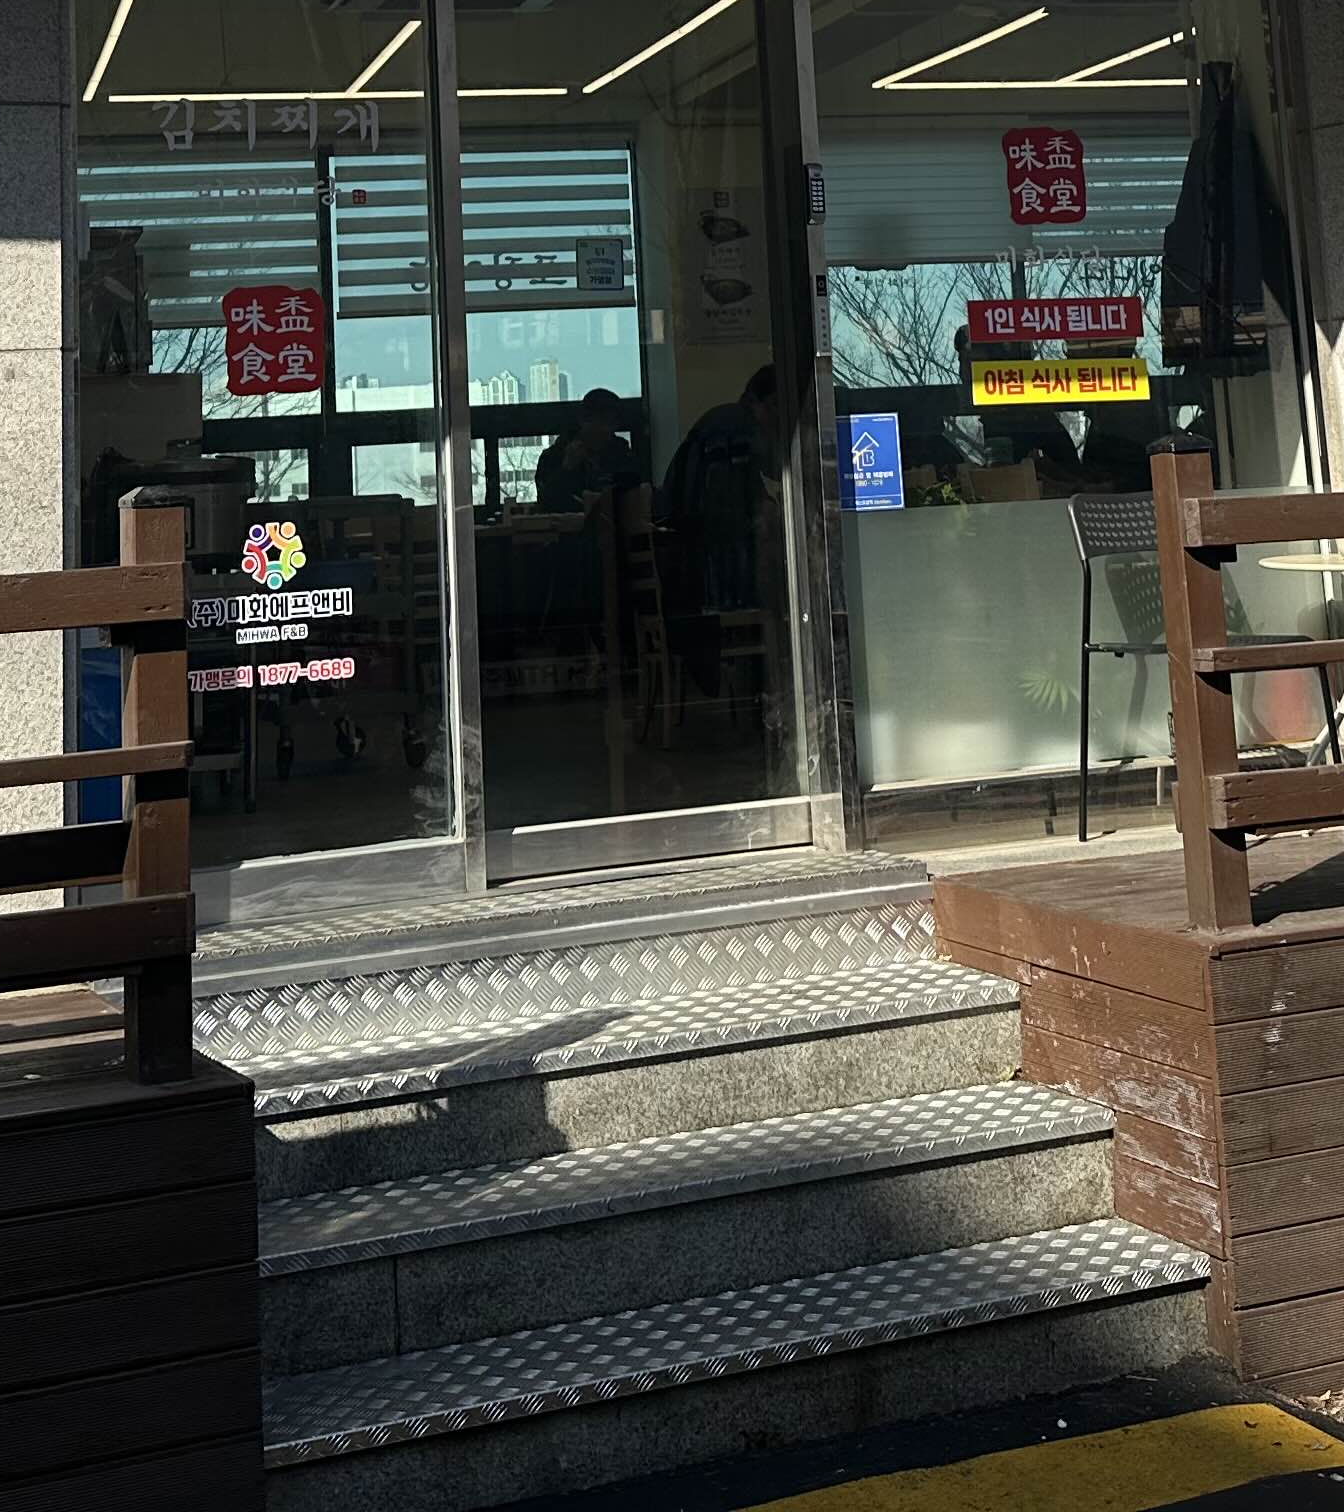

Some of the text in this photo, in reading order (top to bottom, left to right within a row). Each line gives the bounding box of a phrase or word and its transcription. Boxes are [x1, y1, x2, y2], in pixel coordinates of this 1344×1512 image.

[151, 98, 379, 152] 김치찌개
[984, 304, 1128, 334] 1인 식사 됩니다
[984, 366, 1138, 396] 아침 식사 됩니다
[187, 588, 353, 628] (주)미화에프앤비
[236, 624, 307, 644] MIHWA F&B
[188, 658, 355, 692] 가맹문의 1877-6689
